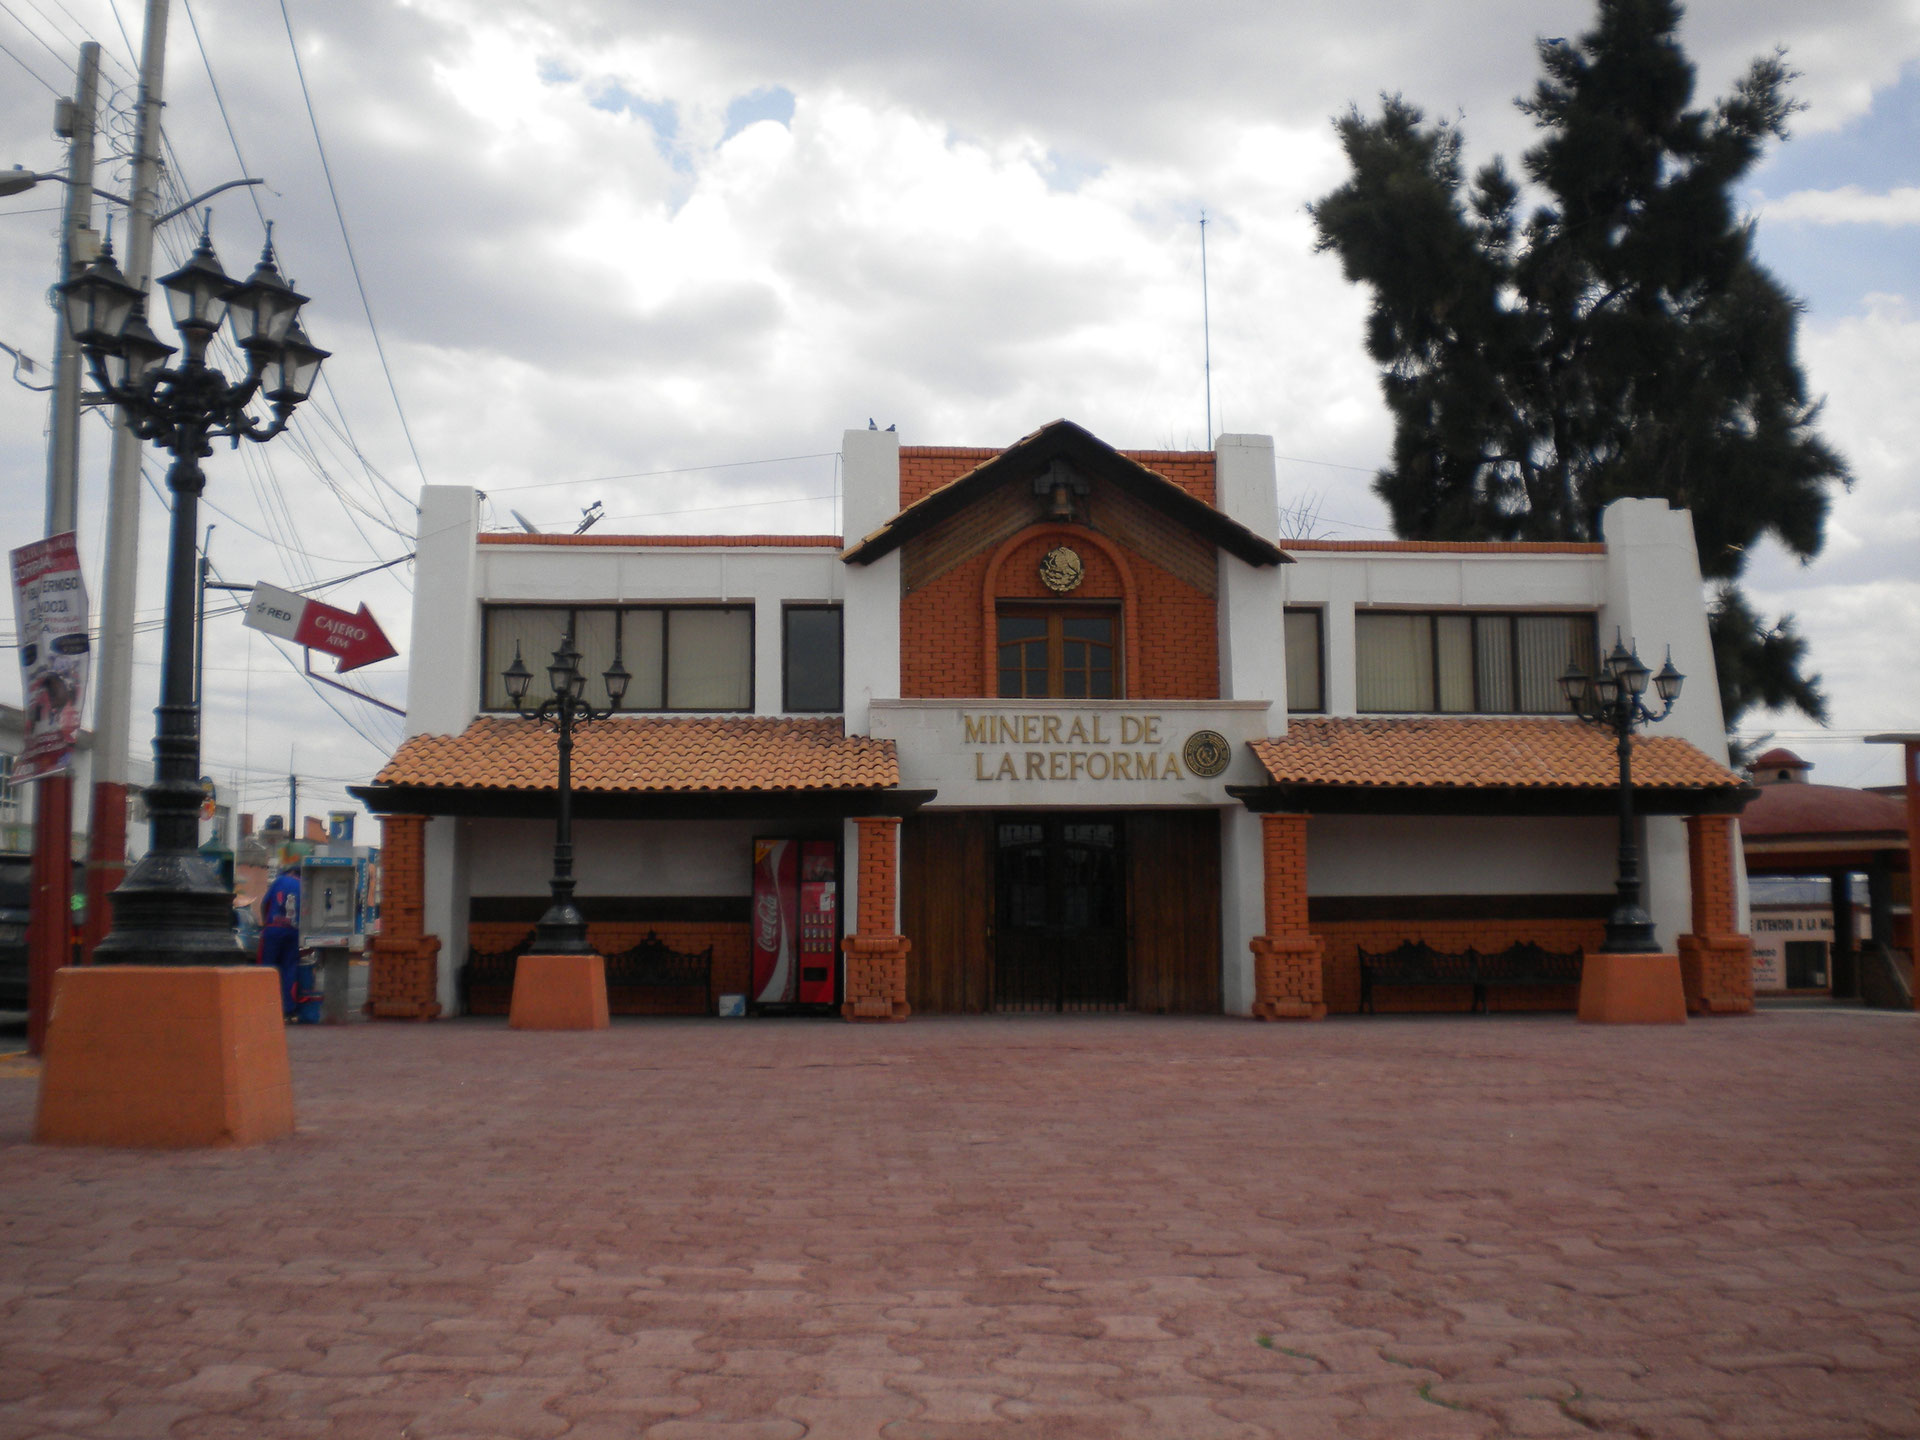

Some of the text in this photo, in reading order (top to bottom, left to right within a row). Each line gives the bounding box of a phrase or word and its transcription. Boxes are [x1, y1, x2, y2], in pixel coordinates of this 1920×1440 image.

[42, 577, 79, 593] ERMOSO
[266, 607, 292, 622] RED
[314, 616, 367, 641] CAJERO
[326, 635, 350, 649] ATM
[964, 714, 1163, 745] MINERAL DE
[975, 751, 1020, 781] LA
[1024, 751, 1185, 781] REFORMA
